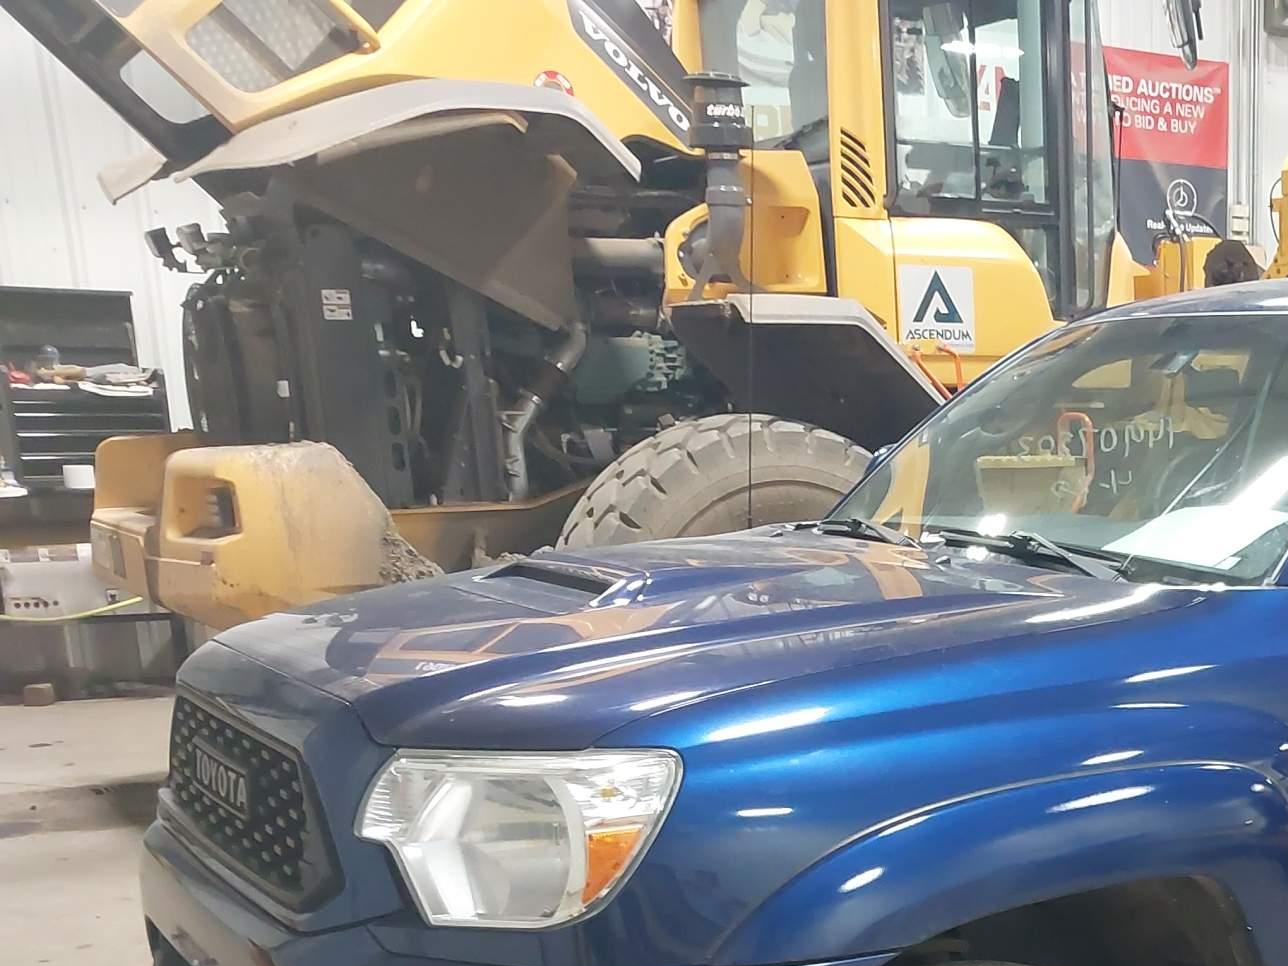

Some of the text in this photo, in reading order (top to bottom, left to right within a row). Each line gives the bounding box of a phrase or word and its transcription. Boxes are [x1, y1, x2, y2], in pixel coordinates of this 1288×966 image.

[579, 10, 691, 131] VOLVO
[1163, 105, 1173, 116] A
[1176, 105, 1205, 119] NEW
[1134, 115, 1154, 131] BID
[1157, 118, 1168, 132] &
[1171, 118, 1197, 135] BUY
[905, 328, 973, 341] ASCENDUM
[195, 747, 248, 809] TOYOTA
